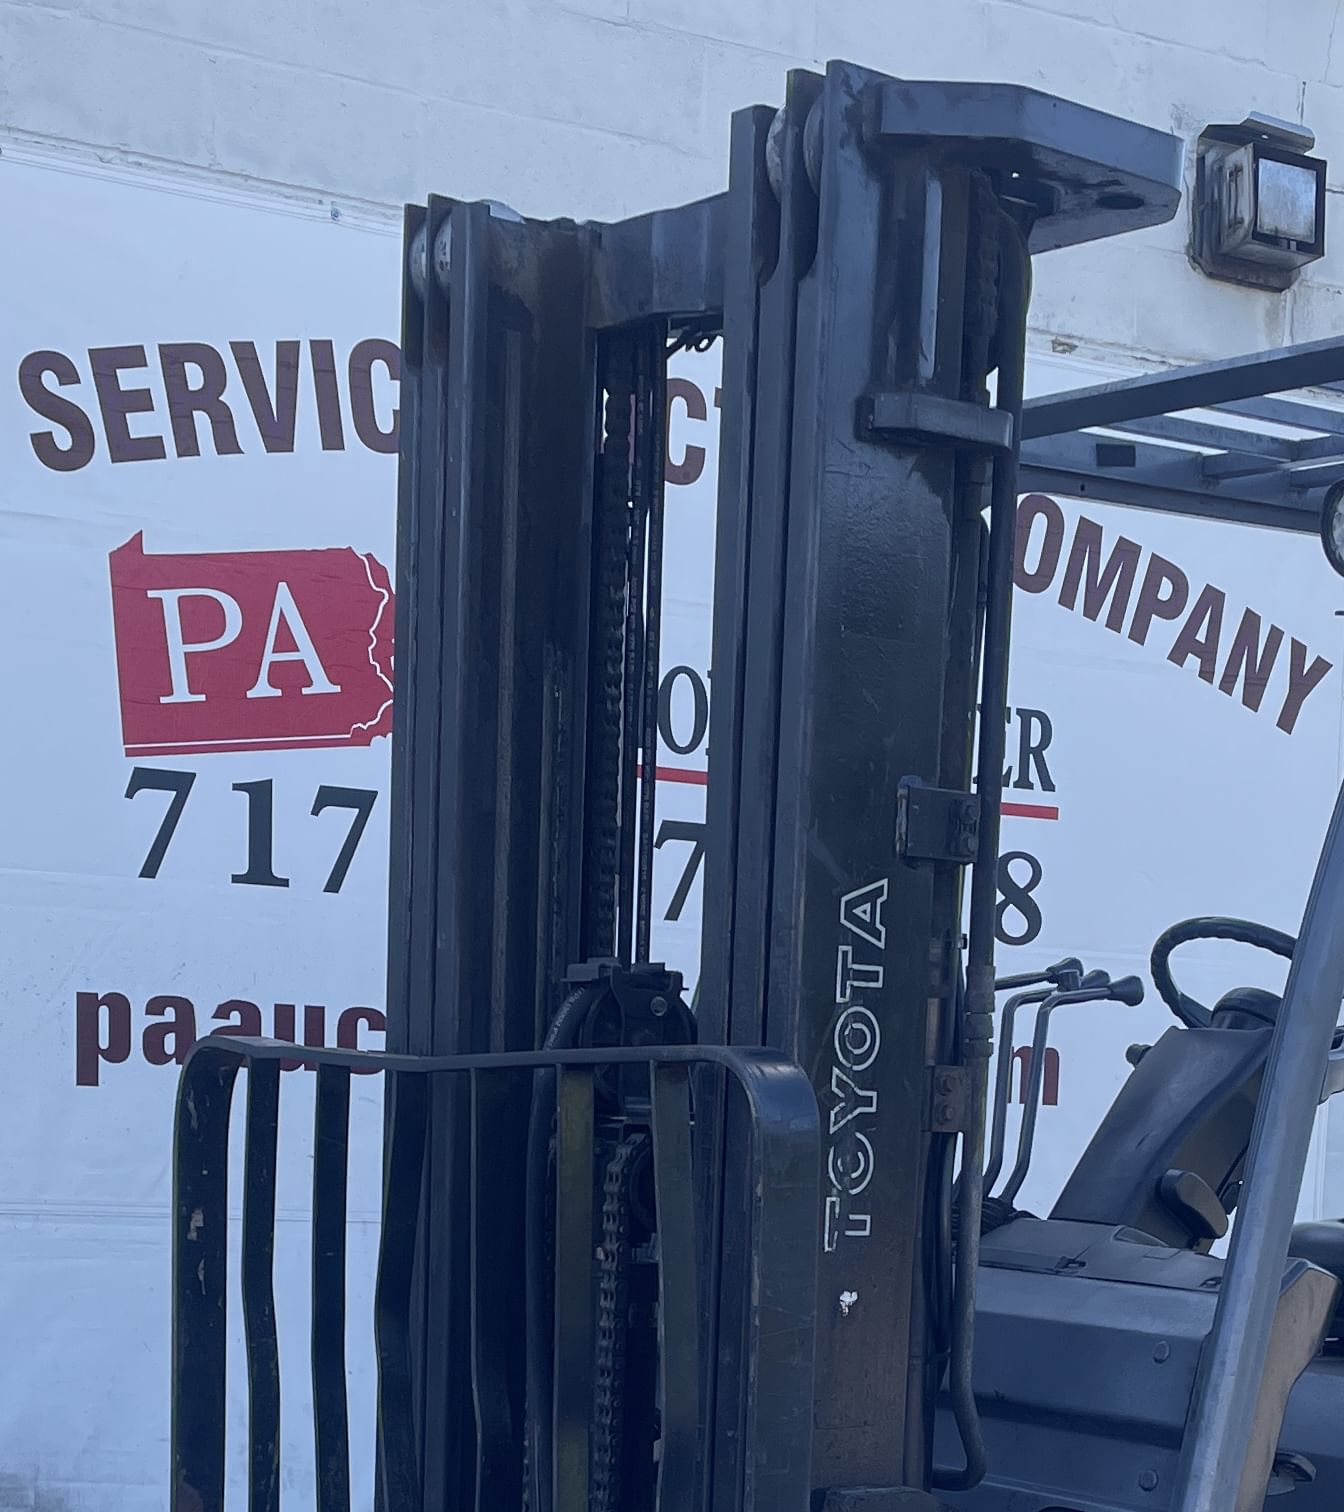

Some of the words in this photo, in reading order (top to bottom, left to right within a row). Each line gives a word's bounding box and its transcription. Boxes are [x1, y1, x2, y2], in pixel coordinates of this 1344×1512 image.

[17, 337, 402, 473] SERVIC
[1011, 493, 1334, 737] OMPANY
[145, 581, 342, 704] PA
